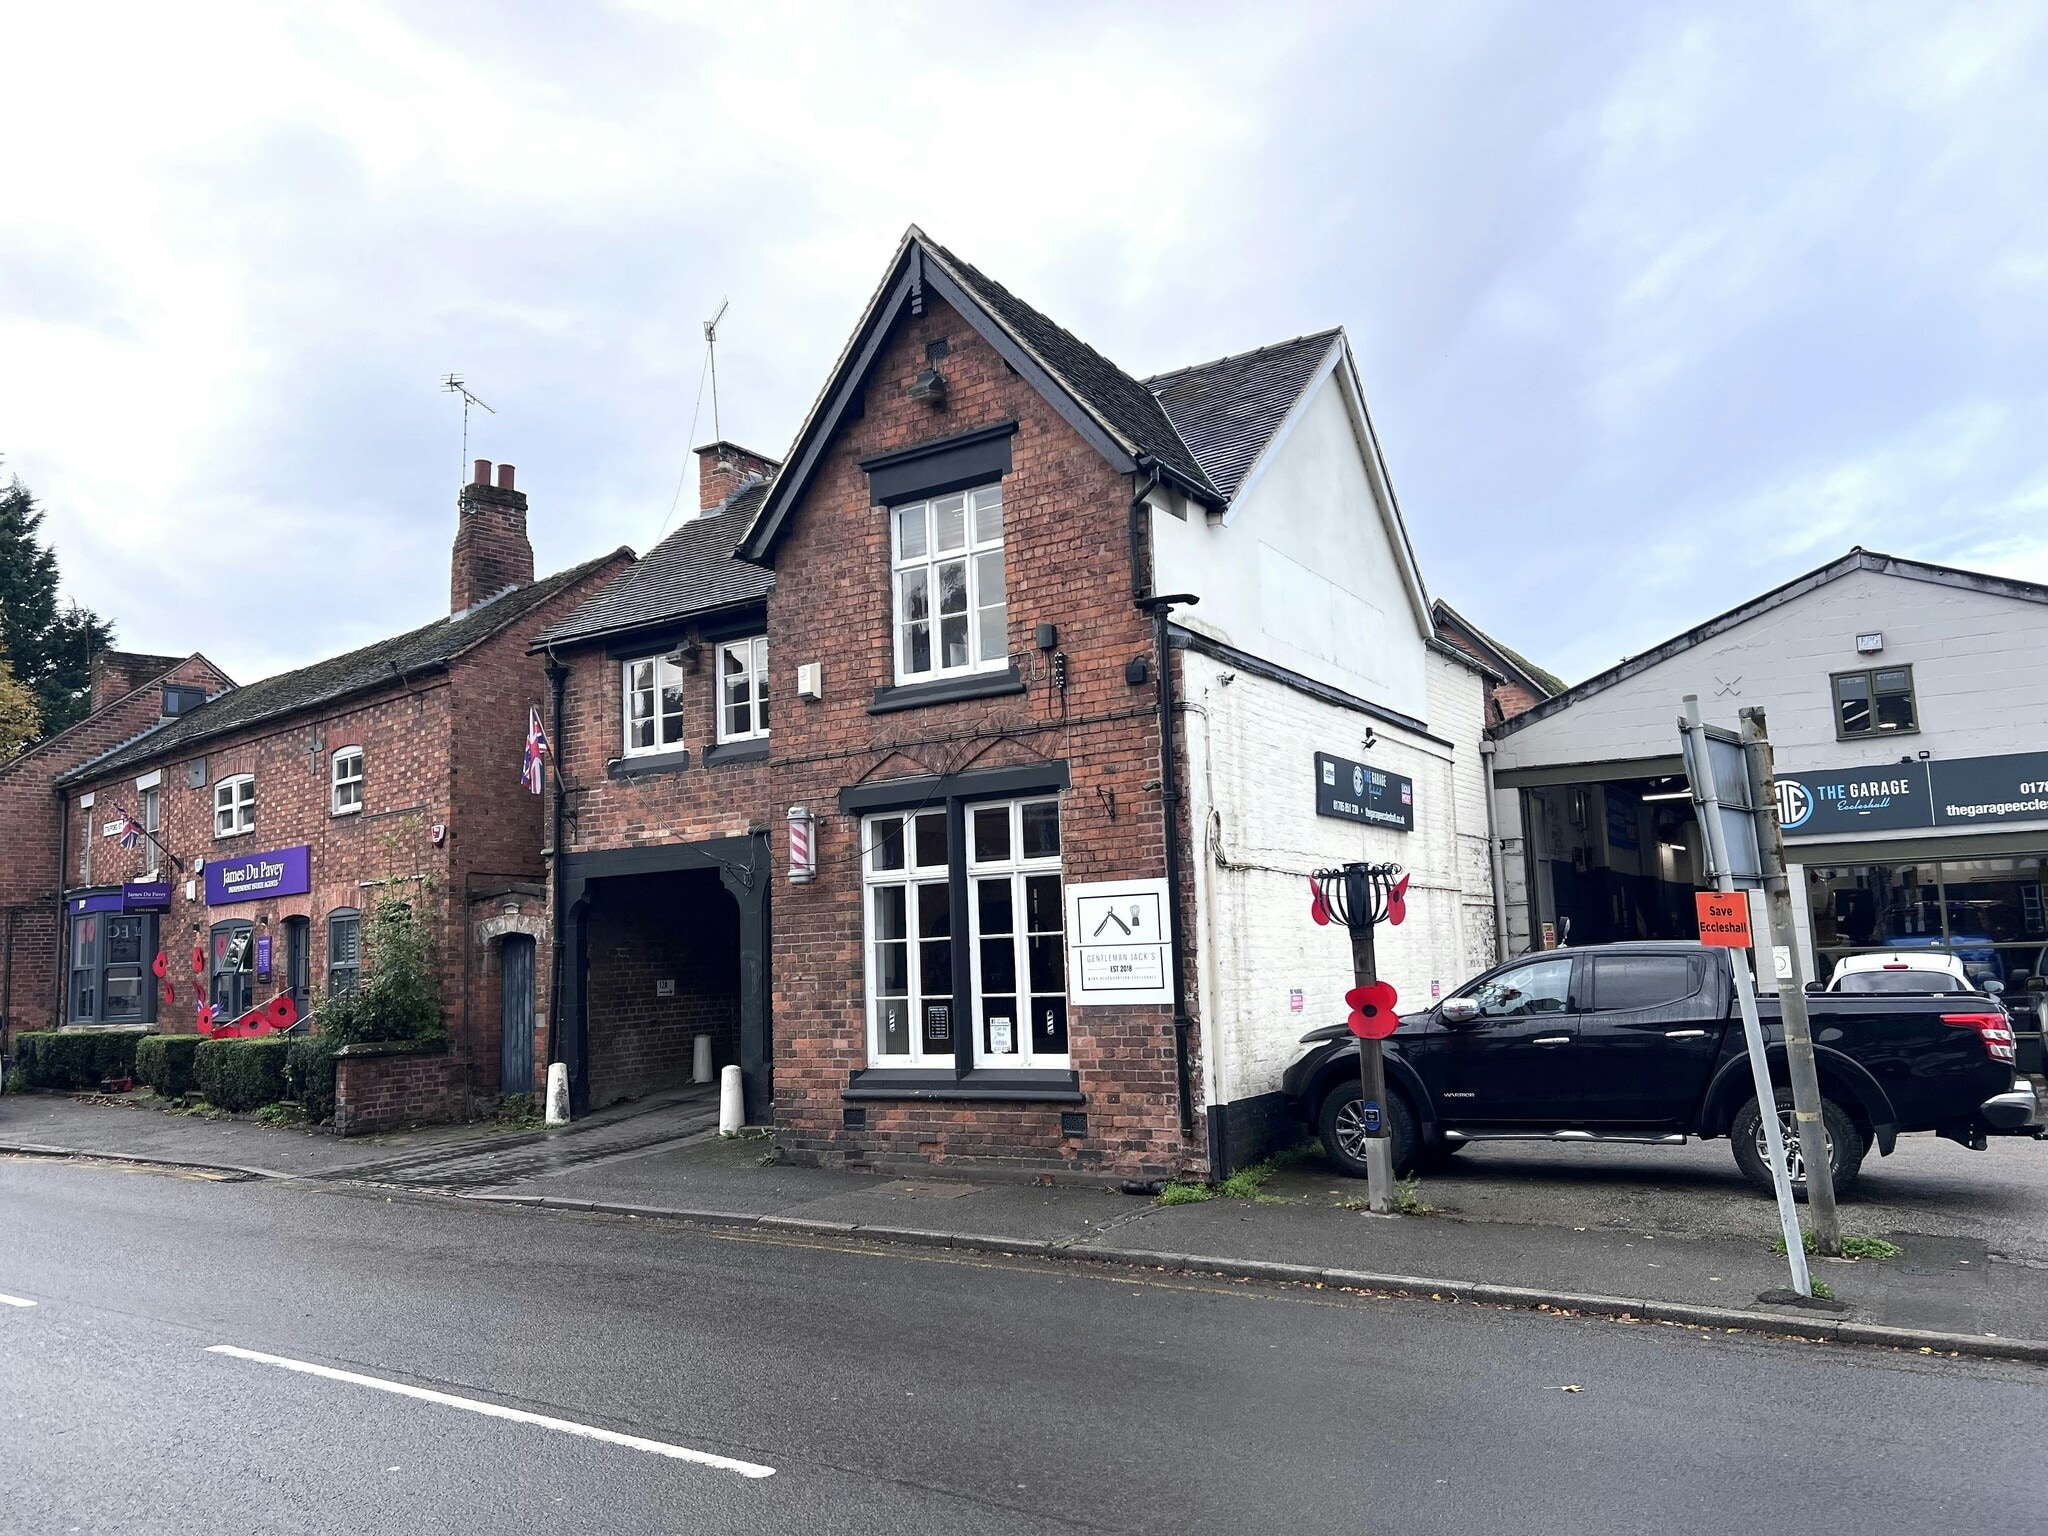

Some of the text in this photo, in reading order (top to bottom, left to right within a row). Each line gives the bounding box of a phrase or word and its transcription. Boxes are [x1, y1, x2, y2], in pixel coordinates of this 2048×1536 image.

[1817, 779, 1910, 800] THE GARAGE
[1837, 797, 1890, 811] Eccleshall
[1946, 798, 2048, 817] thegarageeccle
[222, 861, 284, 887] James Du Pavey
[1709, 906, 1733, 916] Save
[1700, 922, 1747, 933] Eccleshall
[1086, 952, 1156, 963] GENTLEMAN JACK'S
[1110, 964, 1133, 973] EST 2018
